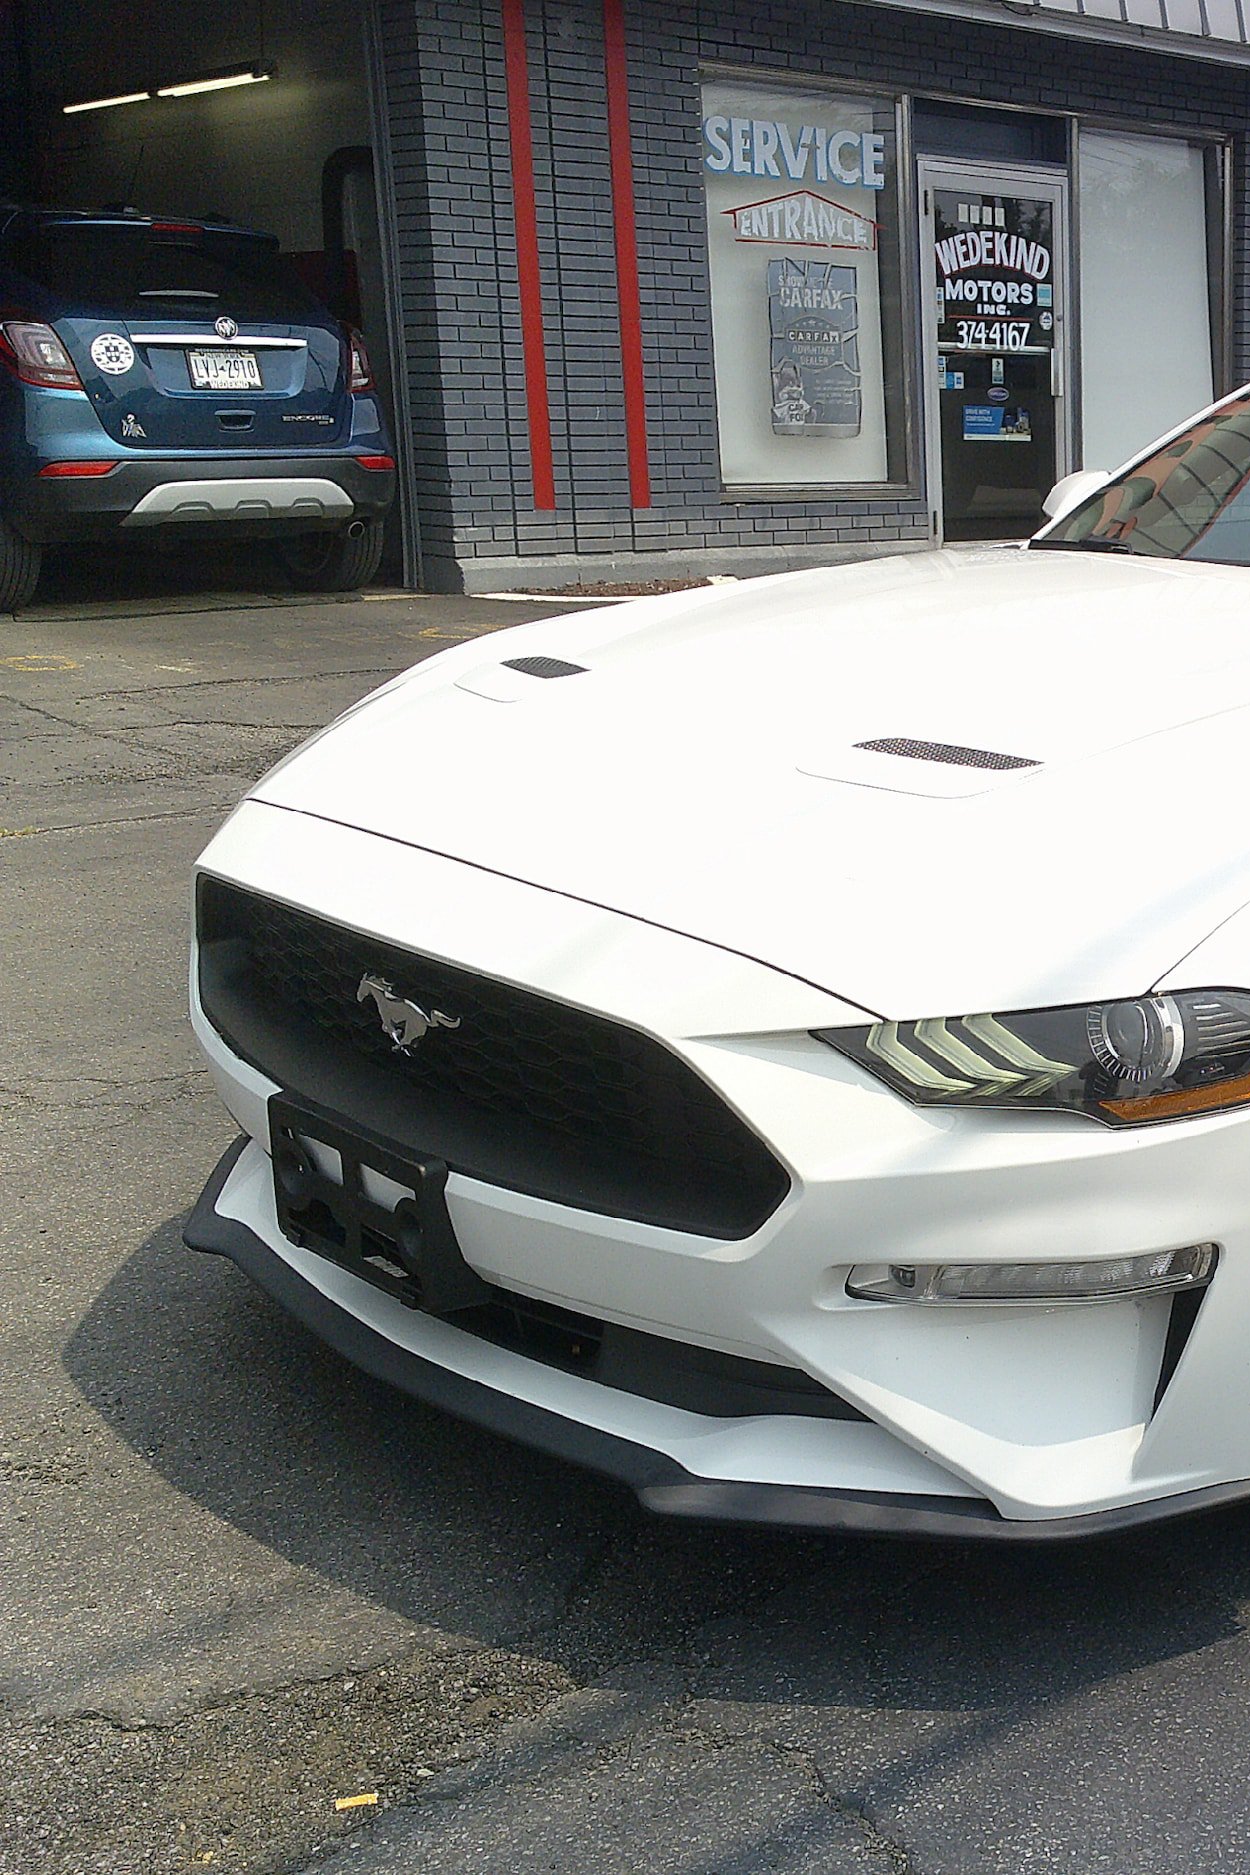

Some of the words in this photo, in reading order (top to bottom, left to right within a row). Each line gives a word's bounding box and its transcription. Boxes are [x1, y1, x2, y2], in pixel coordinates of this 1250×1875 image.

[705, 115, 885, 188] SERVICE
[740, 196, 867, 243] ENTRANCE
[934, 230, 1050, 280] WEDEKIND
[780, 287, 843, 310] CARFAX
[945, 279, 1034, 305] MOTORS
[976, 303, 1011, 316] INC.
[788, 331, 839, 342] CARFAX
[956, 320, 1030, 351] 374-4167
